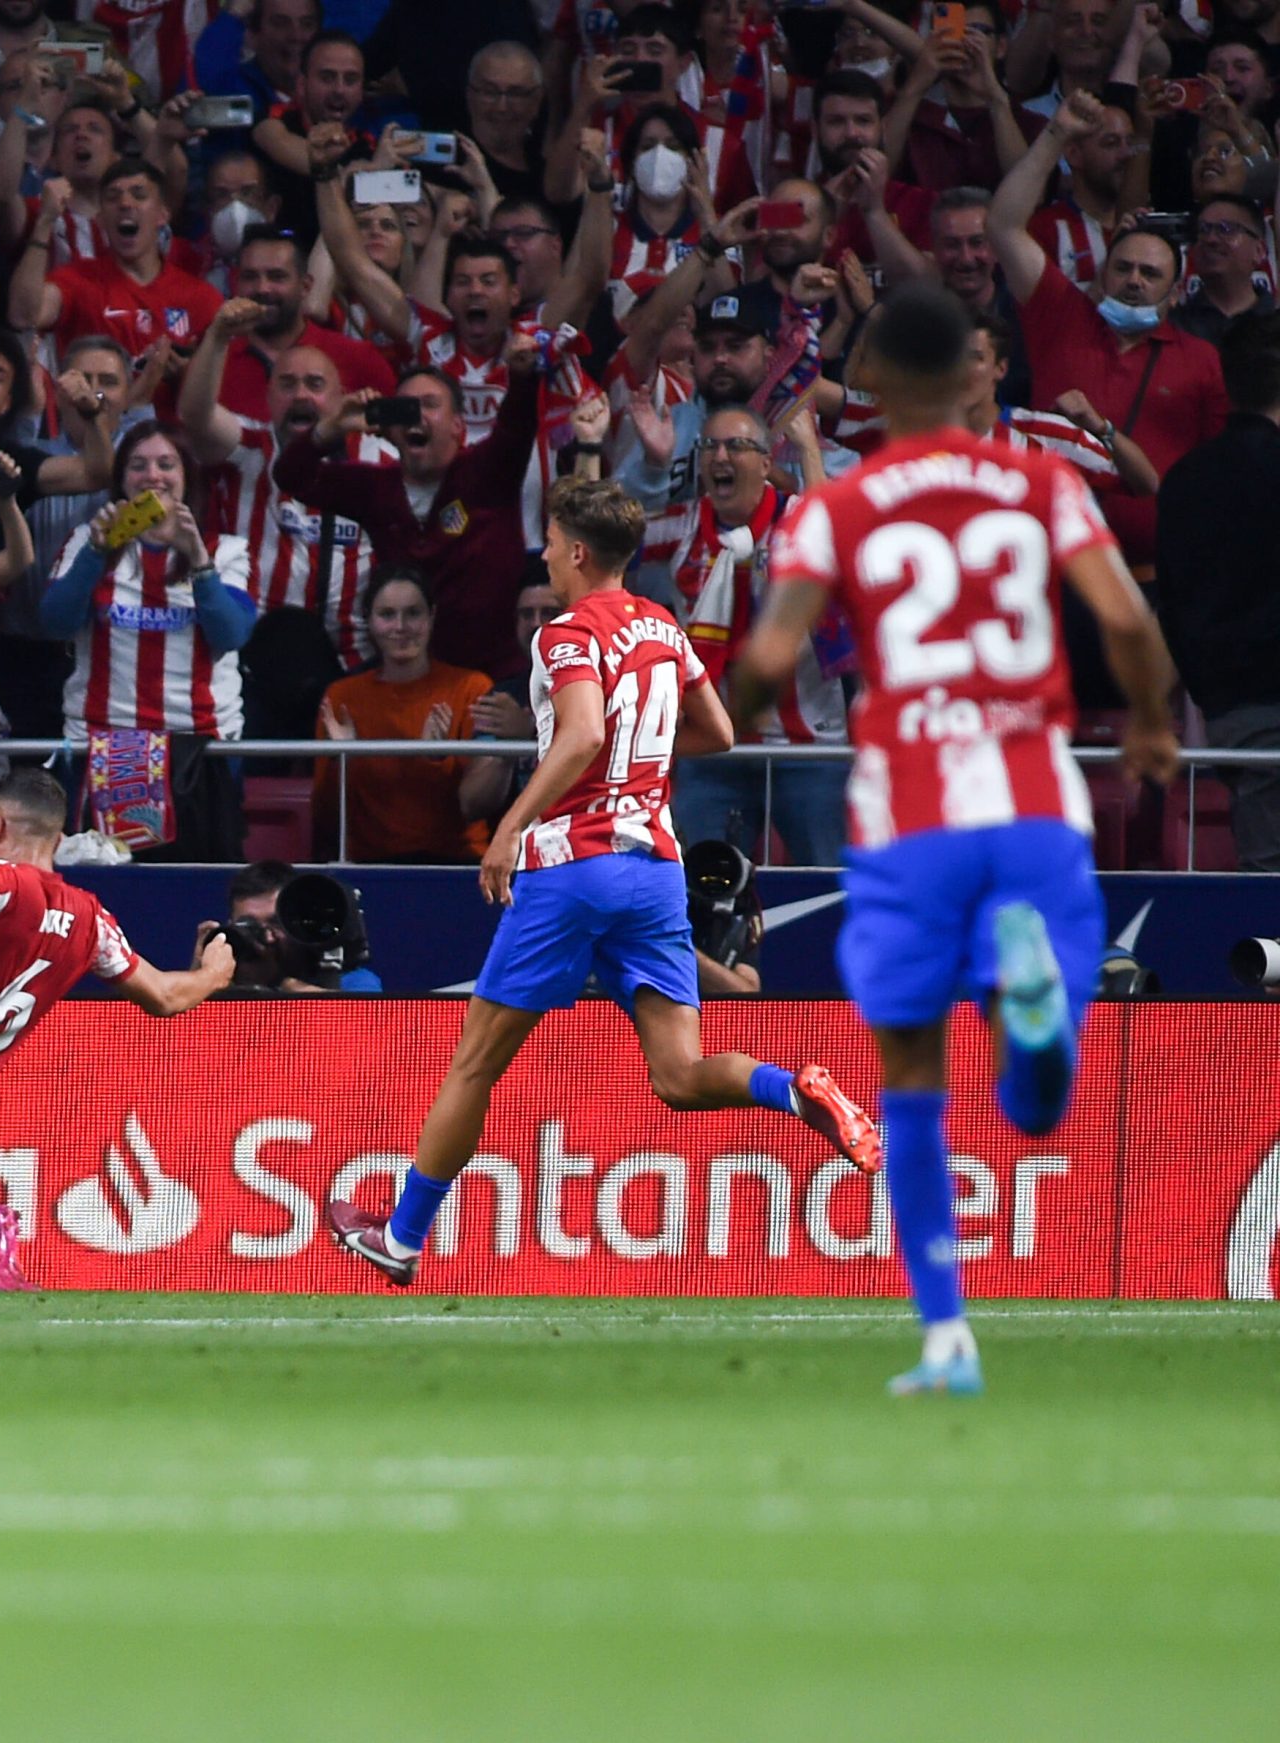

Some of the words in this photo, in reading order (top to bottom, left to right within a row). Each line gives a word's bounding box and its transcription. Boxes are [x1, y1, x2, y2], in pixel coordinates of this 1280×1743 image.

[856, 510, 1055, 690] 23
[605, 661, 678, 784] 14
[229, 1116, 1069, 1260] Santander
